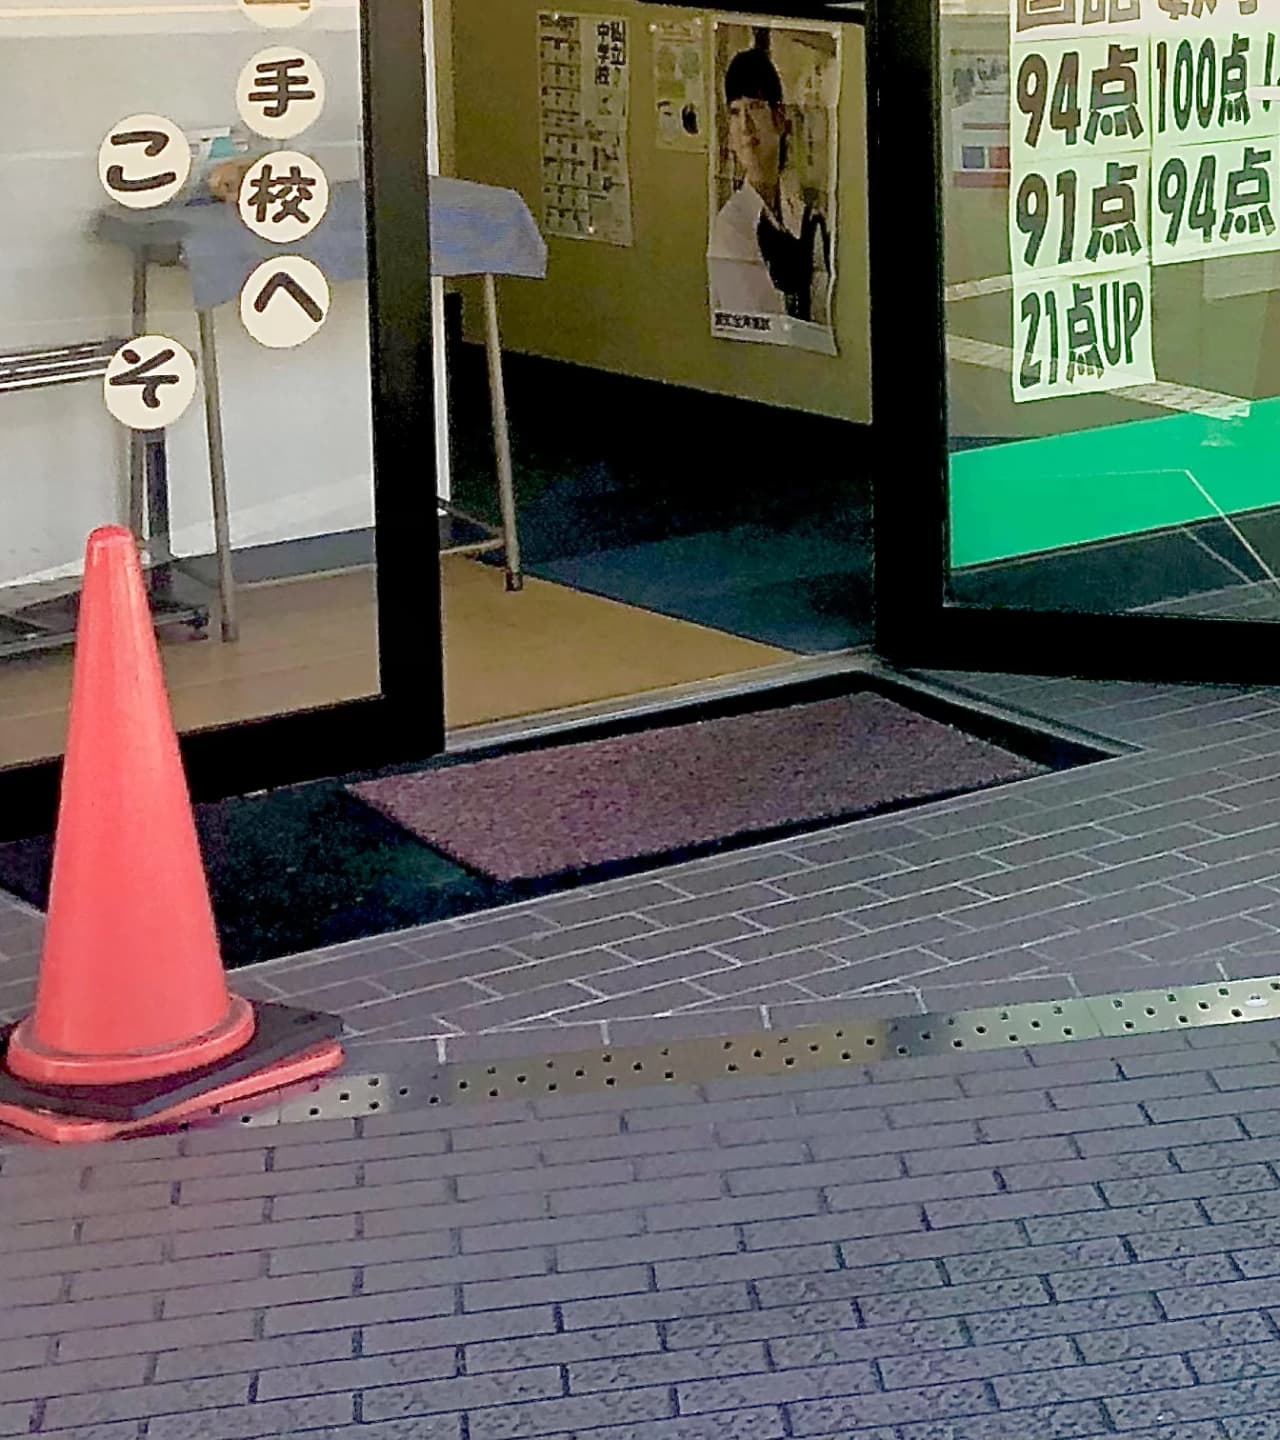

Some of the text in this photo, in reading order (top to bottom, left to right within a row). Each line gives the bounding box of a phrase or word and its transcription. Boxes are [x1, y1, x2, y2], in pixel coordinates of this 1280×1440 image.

[1016, 43, 1144, 148] 94点
[1016, 162, 1143, 268] 91点
[1158, 146, 1273, 246] 94点
[1018, 281, 1144, 390] 21点UP
